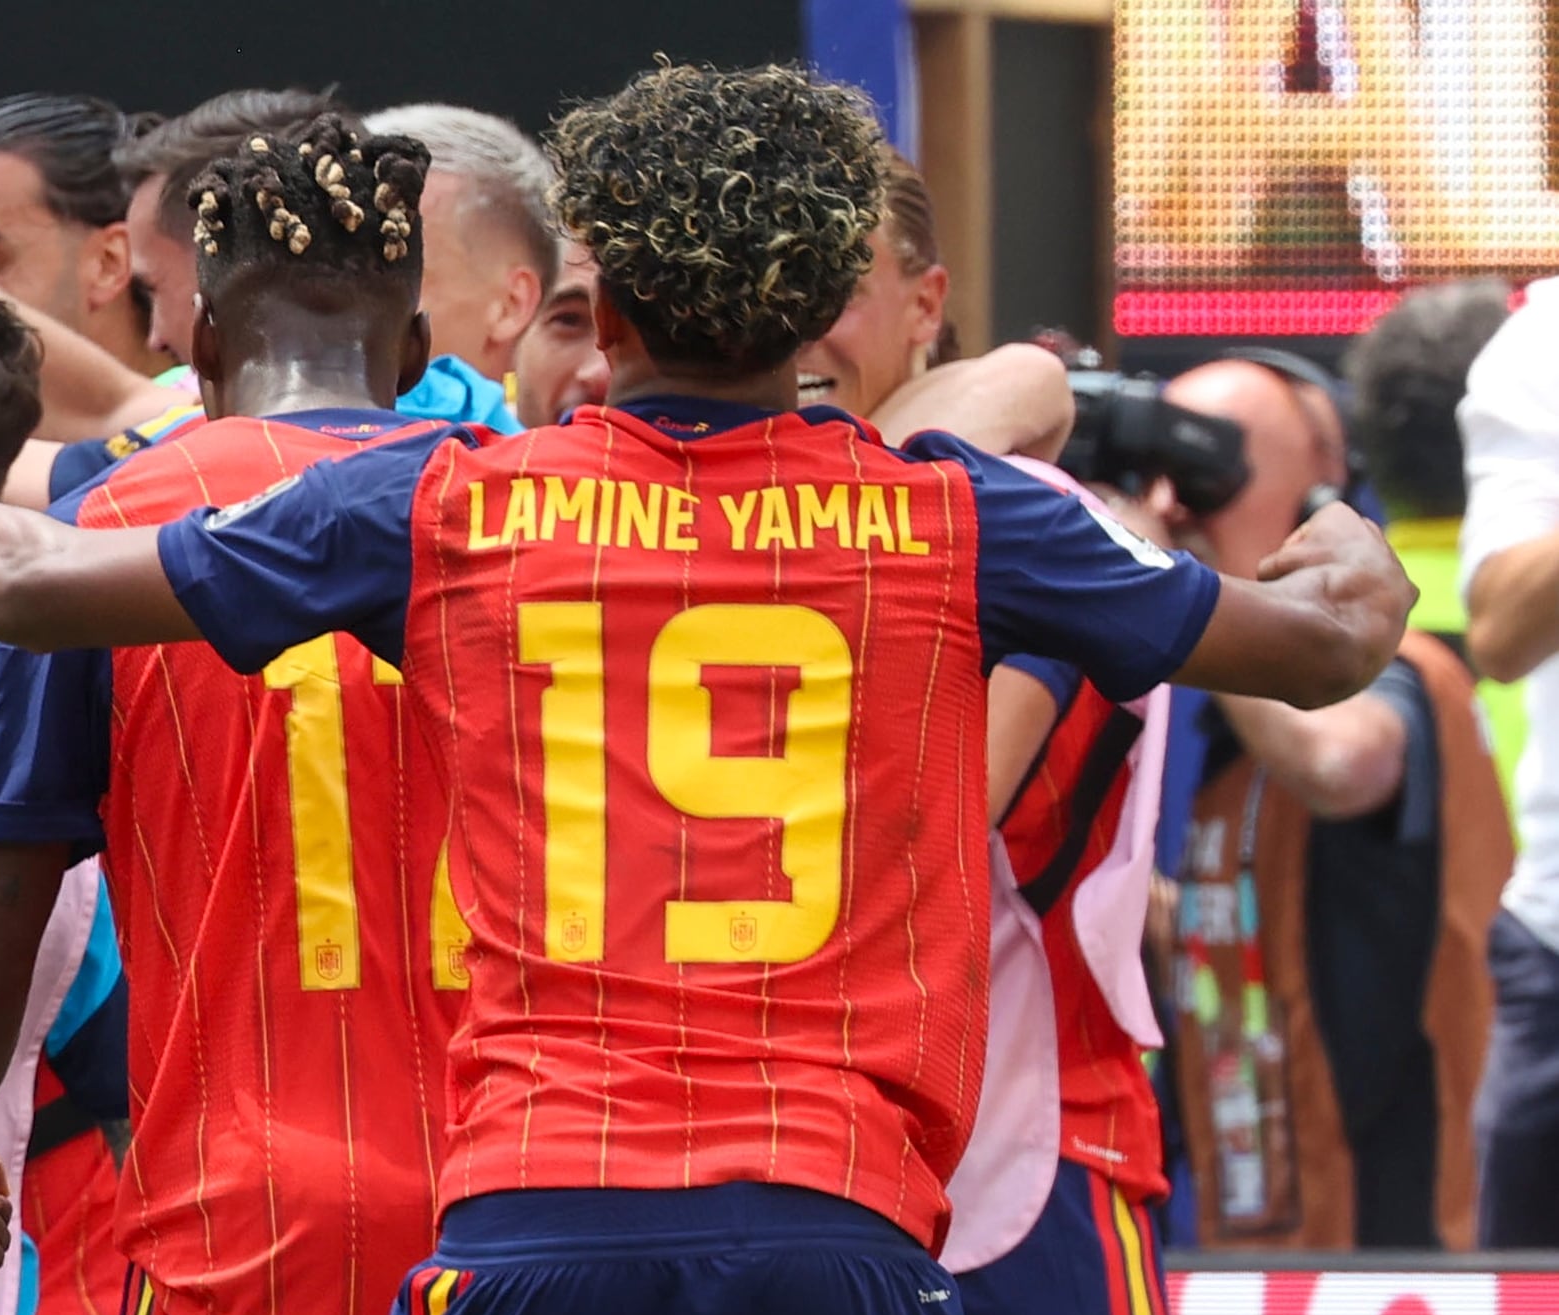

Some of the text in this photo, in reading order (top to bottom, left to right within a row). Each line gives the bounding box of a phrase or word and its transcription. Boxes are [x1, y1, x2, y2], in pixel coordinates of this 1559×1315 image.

[468, 477, 930, 556] LAMINE YAMAL
[518, 601, 853, 963] 19
